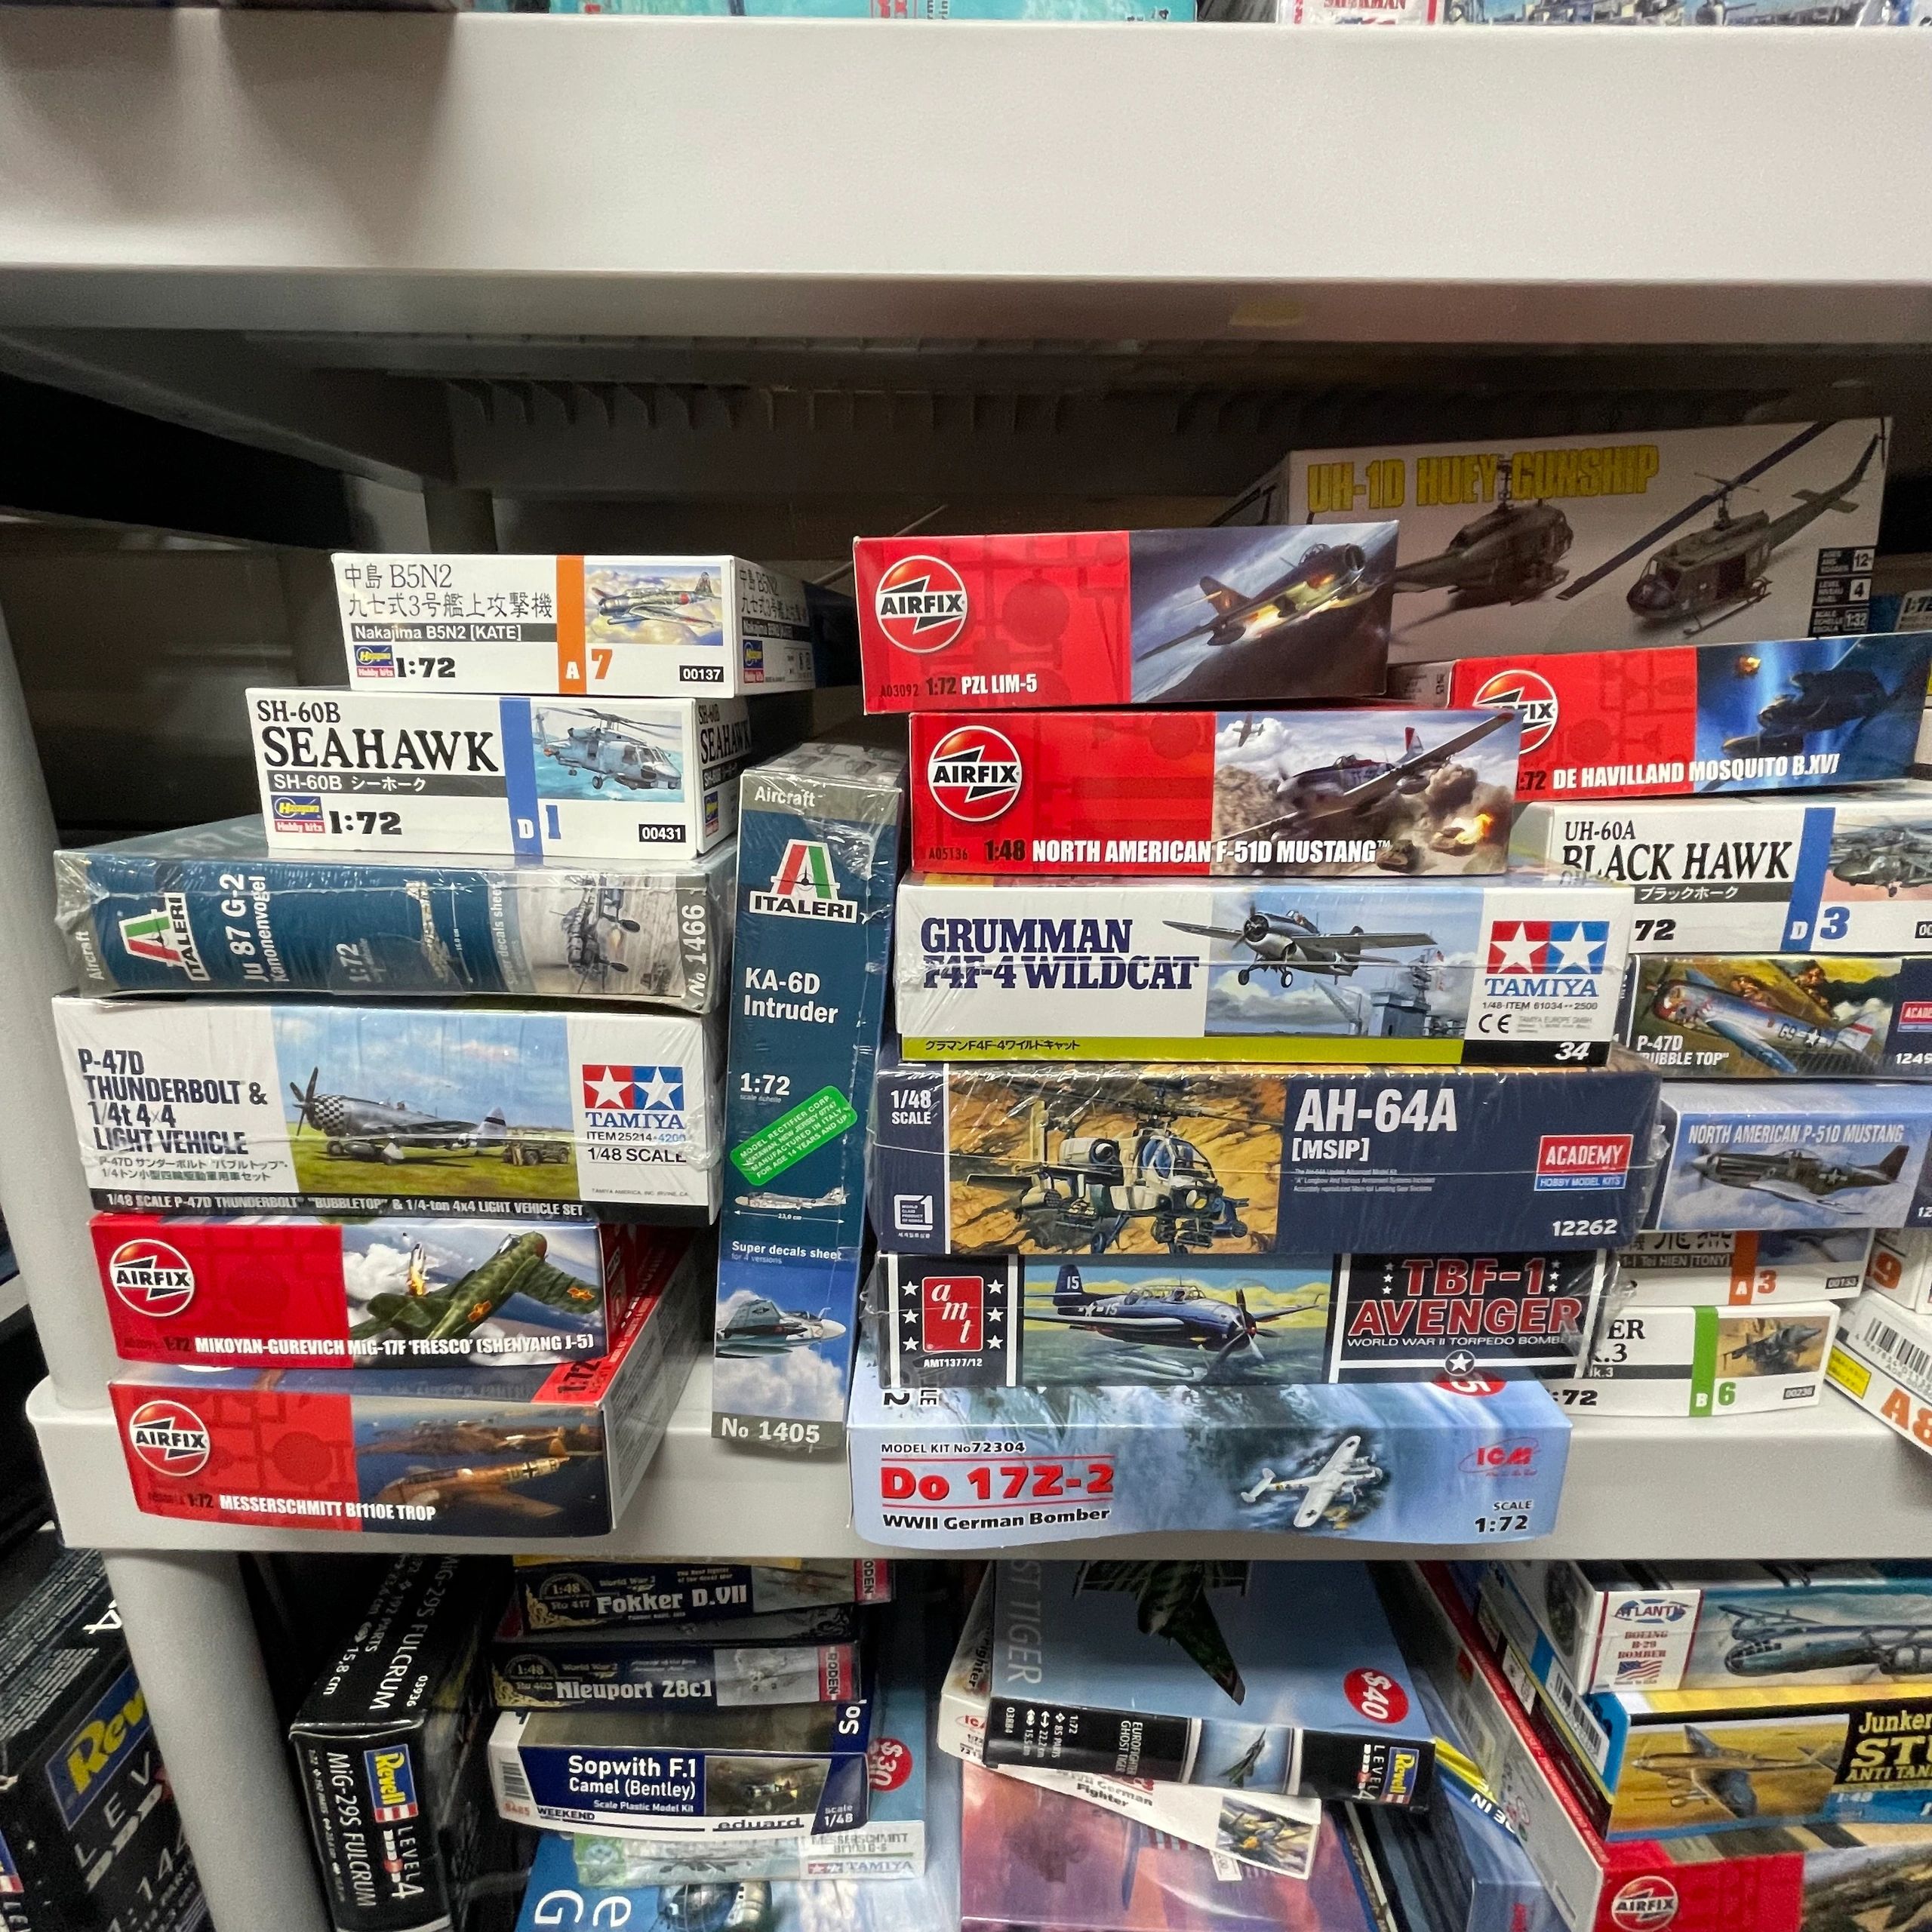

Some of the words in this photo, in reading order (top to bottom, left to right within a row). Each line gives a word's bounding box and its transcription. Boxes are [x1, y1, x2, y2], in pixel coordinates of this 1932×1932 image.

[1307, 459, 1404, 512] UH-1D
[1417, 454, 1499, 506] HUEY
[1511, 444, 1659, 500] GUNSHIP
[390, 565, 452, 588] B5N2
[1854, 582, 1864, 597] 4
[880, 594, 963, 616] AIRFIX
[355, 625, 422, 641] Nakajima
[426, 625, 466, 639] B5N2
[471, 626, 521, 641] [KATE]
[396, 657, 456, 678] 1:72
[566, 661, 580, 679] A
[591, 648, 613, 679] 7
[683, 669, 721, 679] 00137
[880, 685, 918, 697] A03092
[961, 675, 988, 695] PZL
[992, 673, 1038, 694] LIM-5
[257, 700, 341, 723] SH-60B
[262, 726, 499, 771] SEAHAWK
[273, 774, 343, 791] SH-60B
[351, 776, 427, 792] シーホーク
[933, 764, 1019, 783] AIRFIX
[1553, 768, 1577, 789] DE
[1582, 762, 1684, 788] HAVILLAND
[1689, 756, 1788, 782] MOSQUITO
[755, 786, 816, 808] Aircraft
[329, 811, 402, 835] 1:72
[642, 826, 681, 840] 00431
[1564, 820, 1636, 841] UH-60A
[928, 847, 968, 861] A05136
[1032, 840, 1101, 863] NORTH
[1104, 840, 1211, 863] AMERICAN
[1217, 841, 1272, 863] F-51D
[1681, 841, 1792, 880] HAWK
[220, 873, 247, 917] G-2
[1639, 886, 1739, 901] ブラックホーク
[755, 895, 853, 919] ITALERI
[681, 903, 708, 964] 1466
[1820, 906, 1850, 940] 3
[225, 927, 256, 956] 87
[921, 918, 1133, 955] GRUMMAN
[746, 967, 821, 995] KA-6D
[924, 955, 1017, 989] F4F-4
[1022, 956, 1199, 989] WILDCAT
[1484, 978, 1599, 997] TAMIYA
[744, 995, 839, 1024] Intruder
[925, 1040, 1080, 1051] グラマンF4F-4ワイルドキャット
[1555, 1042, 1591, 1060] 34
[1636, 1034, 1683, 1051] P-47D
[78, 1049, 144, 1075] P-47D
[1696, 1051, 1729, 1066] TOP"
[84, 1075, 241, 1105] THUNDERBOLT
[248, 1082, 268, 1105] &
[740, 1072, 790, 1096] 1:72
[891, 1090, 932, 1109] 1/48
[1294, 1088, 1457, 1132] AH-64A
[586, 1112, 685, 1130] TAMIYA
[811, 1122, 822, 1131] IN
[891, 1112, 932, 1124] SCALE
[586, 1131, 617, 1141] ITEM
[1688, 1124, 1732, 1144] NORTH
[1734, 1124, 1801, 1143] AMERICAN
[1841, 1124, 1905, 1143] MUSTANG
[586, 1147, 623, 1161] 1/48
[756, 1164, 773, 1179] FOR
[772, 1155, 789, 1168] AGE
[820, 1122, 837, 1136] AND
[1292, 1137, 1370, 1161] [MSIP]
[1546, 1145, 1624, 1166] ACADEMY
[1571, 1177, 1599, 1187] MODEL
[1601, 1175, 1622, 1186] KITS
[107, 1194, 134, 1207] 1/48
[136, 1195, 172, 1208] SCALE
[174, 1195, 213, 1208] P-47D
[215, 1196, 300, 1209] THUNDERBOLT
[393, 1198, 404, 1211] &
[405, 1198, 451, 1211] 1/4-ton
[453, 1199, 476, 1212] 4x4
[478, 1201, 512, 1214] LIGHT
[514, 1202, 561, 1215] VEHICLE
[562, 1204, 583, 1217] SET
[1552, 1220, 1617, 1237] 12262
[731, 1241, 766, 1255] Super
[769, 1244, 807, 1257] decals
[810, 1249, 842, 1260] sheet
[751, 1255, 783, 1265] versions
[1660, 1254, 1687, 1266] HIEN
[1690, 1254, 1730, 1267] [TONY]
[116, 1269, 189, 1287] AIRFIX
[1067, 1275, 1079, 1290] 15
[1401, 1257, 1546, 1297] TBF-1
[1736, 1281, 1747, 1294] A
[1758, 1270, 1777, 1294] 3
[1105, 1303, 1118, 1315] 15
[1348, 1297, 1583, 1336] AVENGER
[195, 1337, 344, 1355] MIKOYAN-GUREVICH
[1347, 1337, 1398, 1346] WORLD
[1402, 1337, 1435, 1346] WAR
[1450, 1336, 1515, 1346] TORPEDO
[924, 1358, 983, 1368] AMT1377/12
[1696, 1393, 1708, 1407] B
[1718, 1382, 1736, 1406] 6
[136, 1431, 206, 1448] AIRFIX
[721, 1417, 749, 1438] No
[758, 1421, 820, 1444] 1405
[881, 1444, 926, 1453] MODEL
[931, 1443, 950, 1453] KIT
[881, 1467, 950, 1500] Do
[967, 1463, 1114, 1500] 17Z-2
[220, 1494, 343, 1517] MESSERSCHMITT
[397, 1505, 436, 1521] TROP
[1494, 1500, 1533, 1511] SCALE
[943, 1514, 1024, 1530] German
[1029, 1509, 1111, 1525] Bomber
[1475, 1515, 1528, 1533] 1:72
[596, 1592, 683, 1615] Fokker
[1625, 1631, 1669, 1639] BOEING
[1618, 1650, 1666, 1659] BOMBER
[370, 1623, 429, 1711] FULCRUM
[827, 1653, 838, 1695] RODEN
[555, 1681, 654, 1700] Nieuport
[1361, 1671, 1392, 1720] $40
[1068, 1715, 1079, 1734] 1:72
[1118, 1719, 1131, 1753] GHOST
[568, 1755, 661, 1780] Sopwith
[669, 1758, 696, 1778] F.1
[1366, 1744, 1386, 1792] LEVEL
[1389, 1752, 1416, 1795] Revell
[374, 1752, 407, 1805] Revell
[569, 1777, 619, 1795] Camel
[624, 1778, 696, 1801] (Bentley)
[326, 1751, 362, 1829] MiG-29S
[1352, 1789, 1376, 1801] 4
[538, 1806, 595, 1820] WEEKEND
[594, 1799, 618, 1809] Scale
[620, 1801, 651, 1810] Plastic
[652, 1802, 679, 1812] Model
[681, 1804, 694, 1812] Kit
[825, 1804, 854, 1814] scale
[718, 1817, 801, 1832] eduard
[823, 1813, 854, 1828] 1/48
[397, 1825, 422, 1881] LEVEL
[343, 1831, 377, 1907] FULCRUM
[844, 1860, 914, 1871] TAMIYA
[391, 1881, 425, 1900] 4
[1615, 1897, 1675, 1913] AIRFIX
